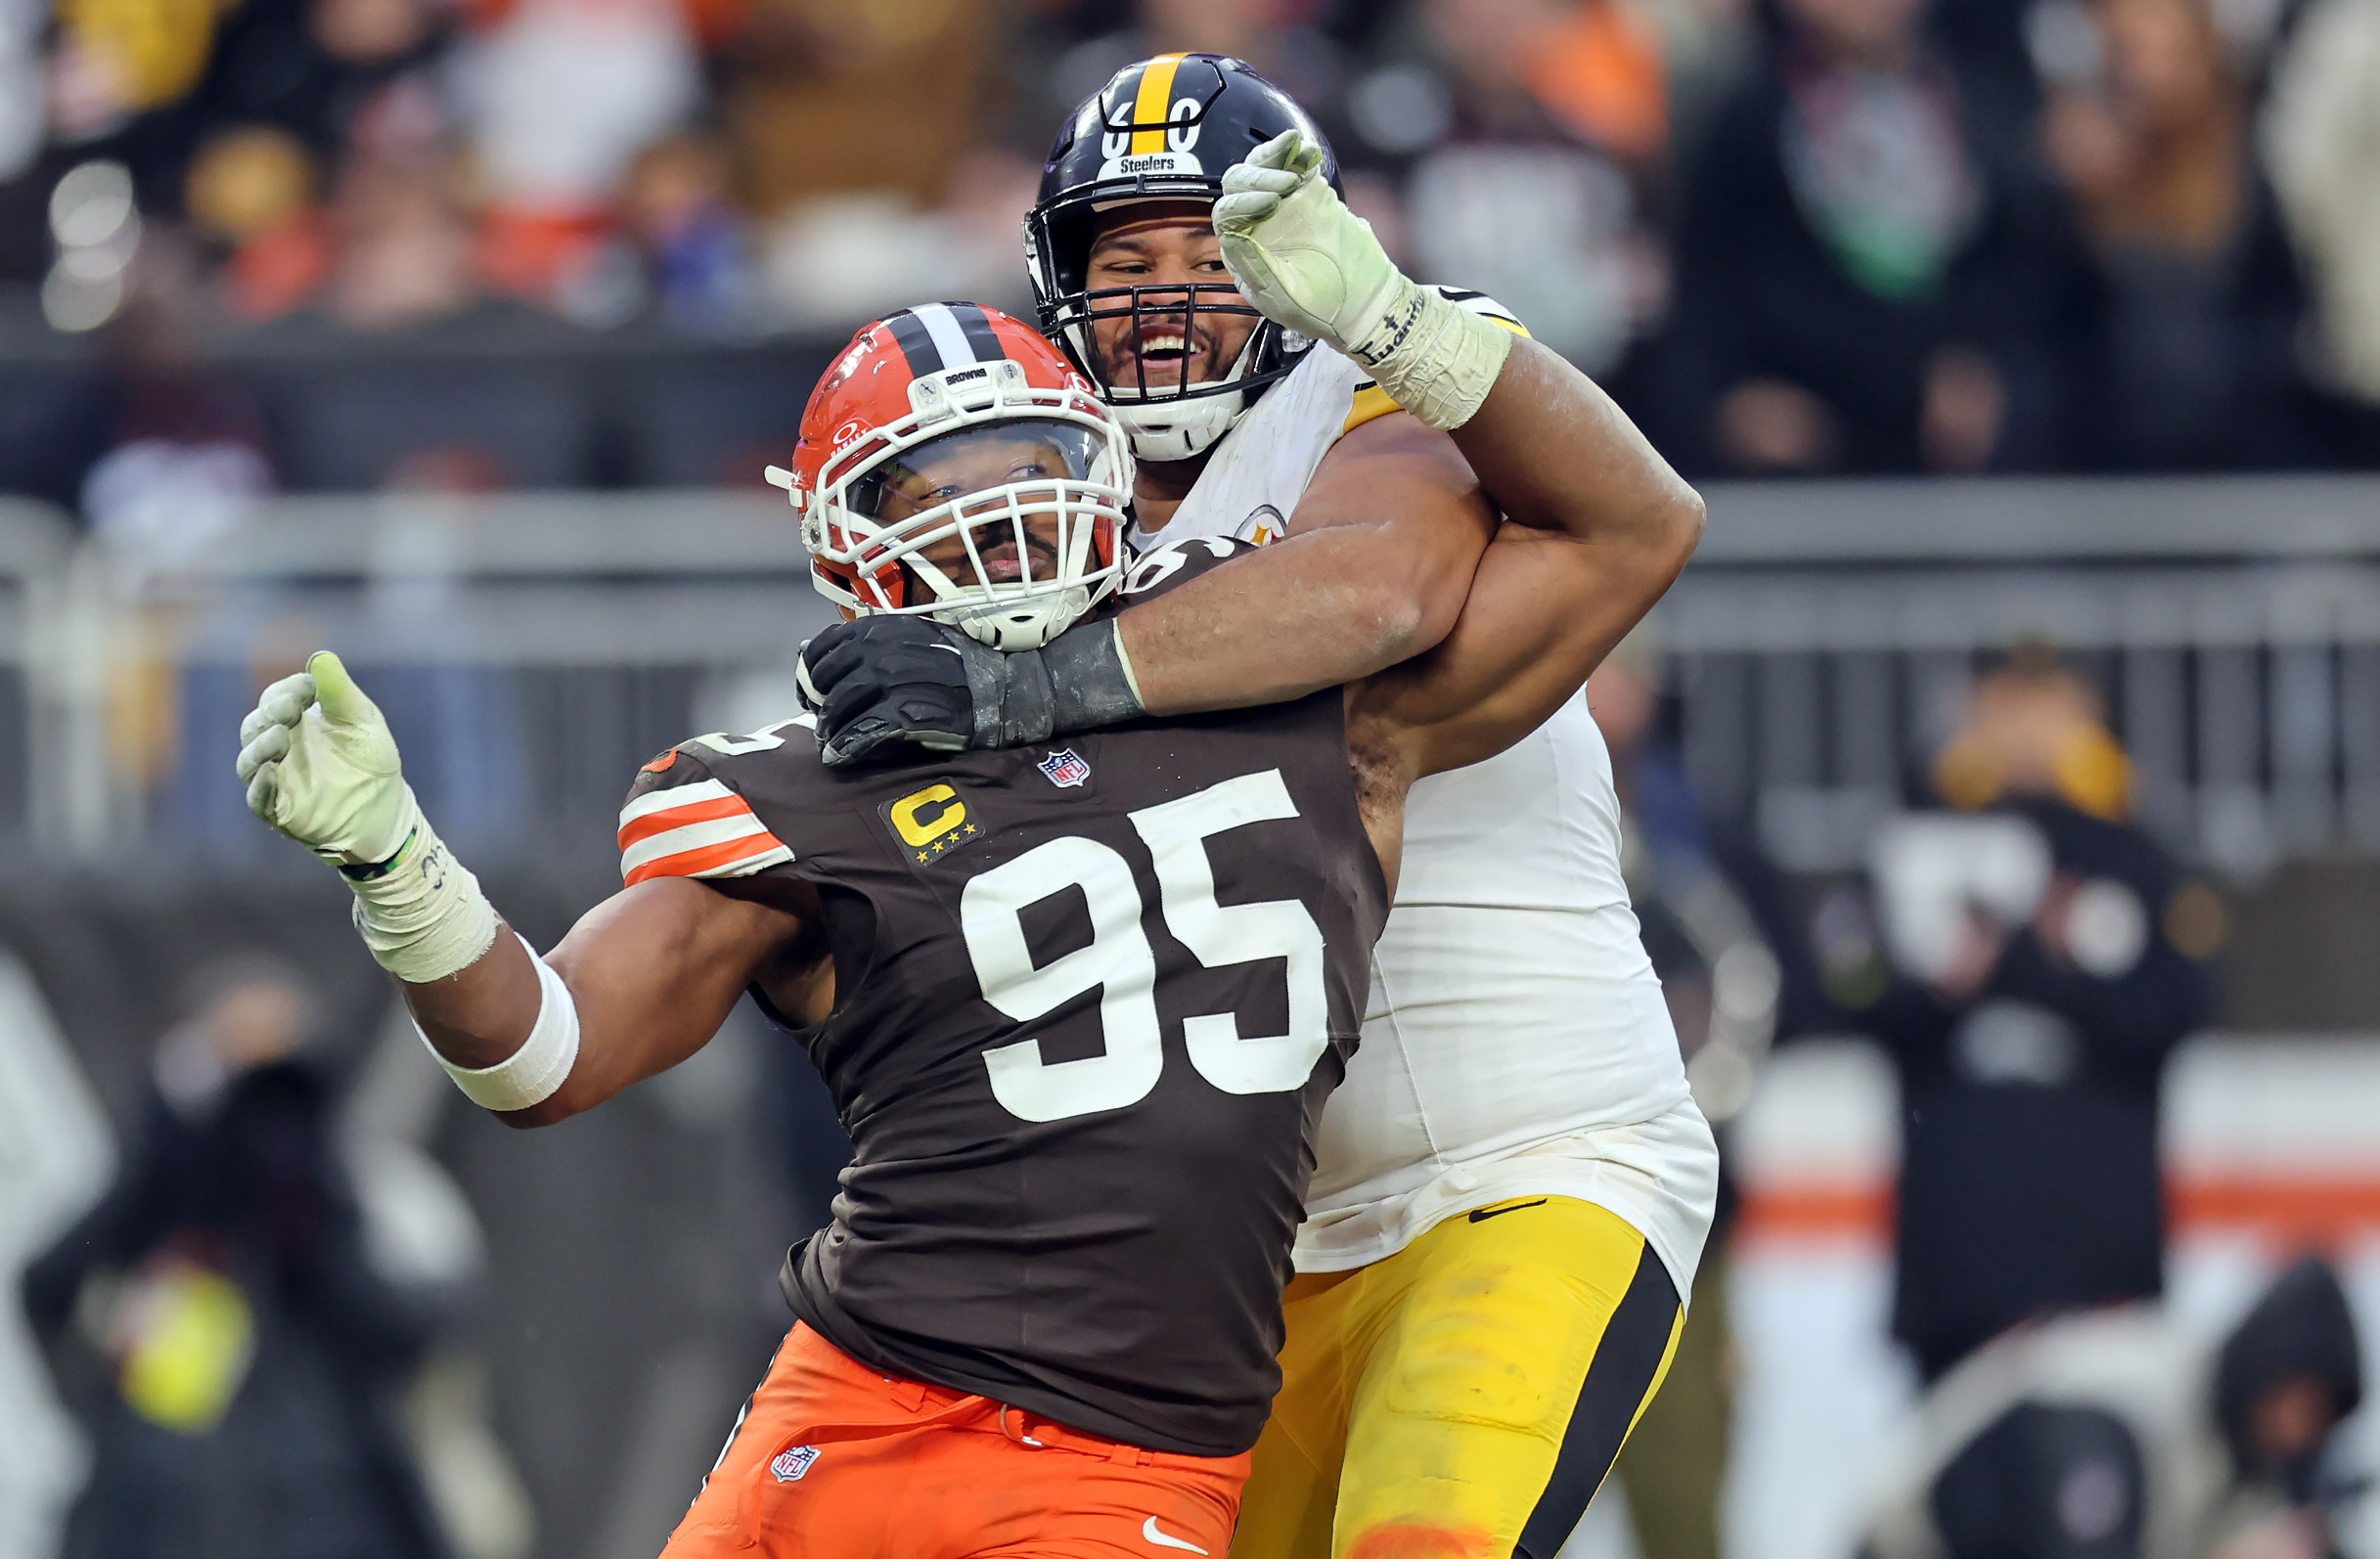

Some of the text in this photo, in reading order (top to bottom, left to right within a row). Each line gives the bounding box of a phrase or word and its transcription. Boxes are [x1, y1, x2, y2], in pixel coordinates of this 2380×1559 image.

[1101, 98, 1202, 159] 60
[1120, 155, 1175, 174] Steelers
[945, 368, 987, 385] BROWNS
[1053, 762, 1084, 781] NFL
[890, 783, 966, 846] C
[960, 768, 1328, 1123] 95
[777, 1454, 802, 1474] NFL
